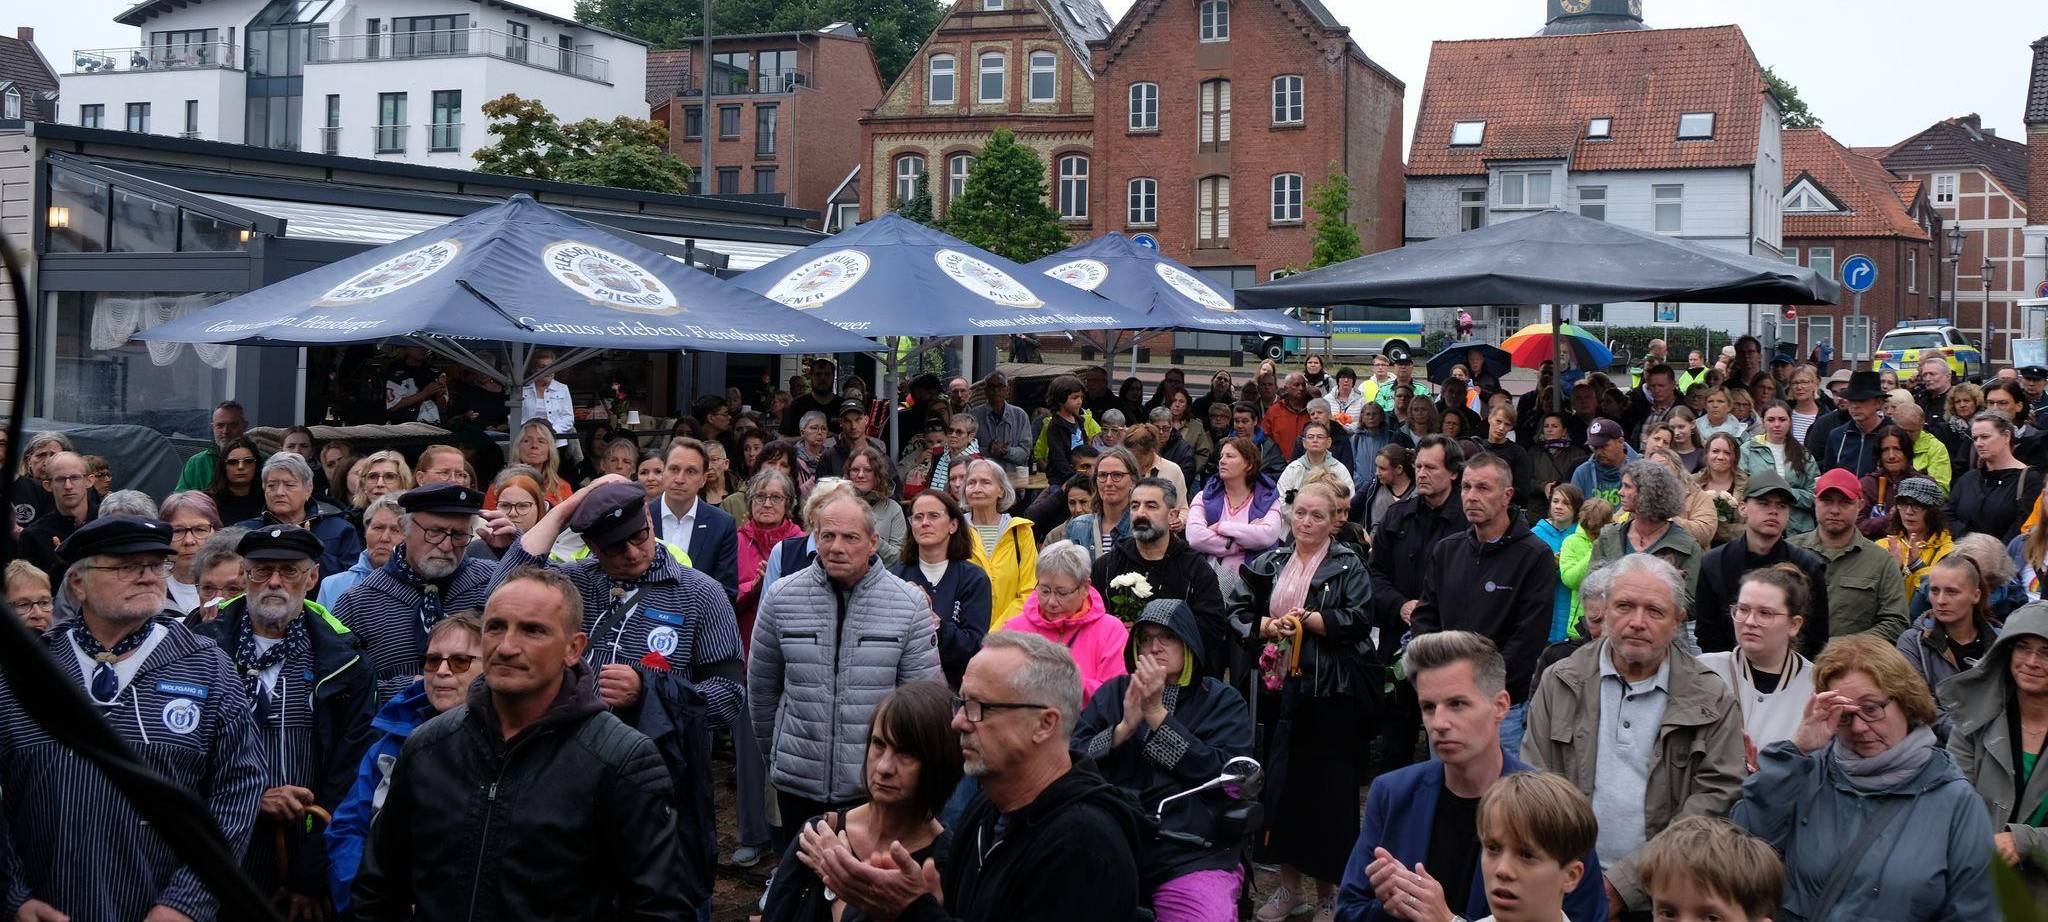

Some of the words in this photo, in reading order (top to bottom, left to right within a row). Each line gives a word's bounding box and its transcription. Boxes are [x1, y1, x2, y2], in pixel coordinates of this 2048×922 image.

[553, 246, 644, 278] FLENSBURGER
[594, 288, 664, 306] PILSENER
[518, 316, 604, 335] Genuss
[606, 321, 690, 337] erleben.
[685, 325, 806, 347] Flensburger.
